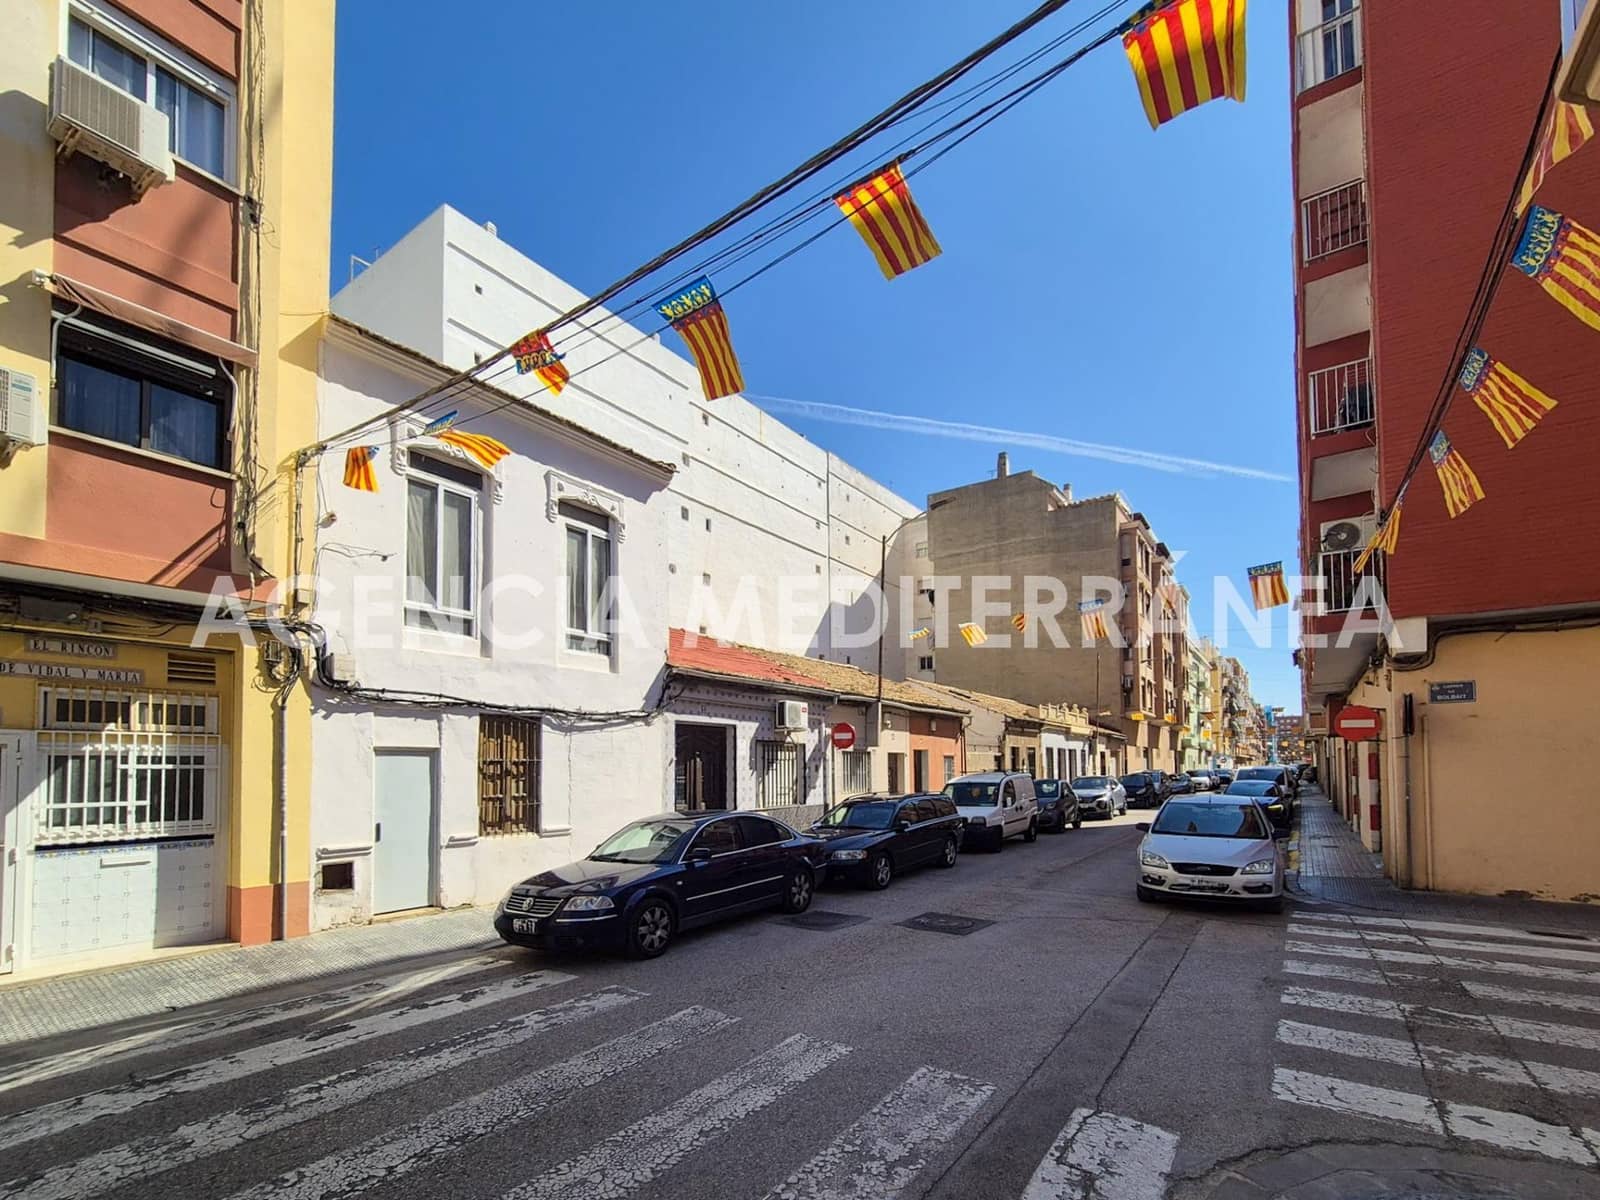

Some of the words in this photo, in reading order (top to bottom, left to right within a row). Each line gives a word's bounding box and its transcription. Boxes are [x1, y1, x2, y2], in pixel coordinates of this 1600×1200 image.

[33, 640, 49, 651] EL
[60, 641, 111, 657] RINCON
[28, 664, 71, 678] VIDAL
[81, 669, 90, 679] Y
[97, 671, 140, 682] MARIA
